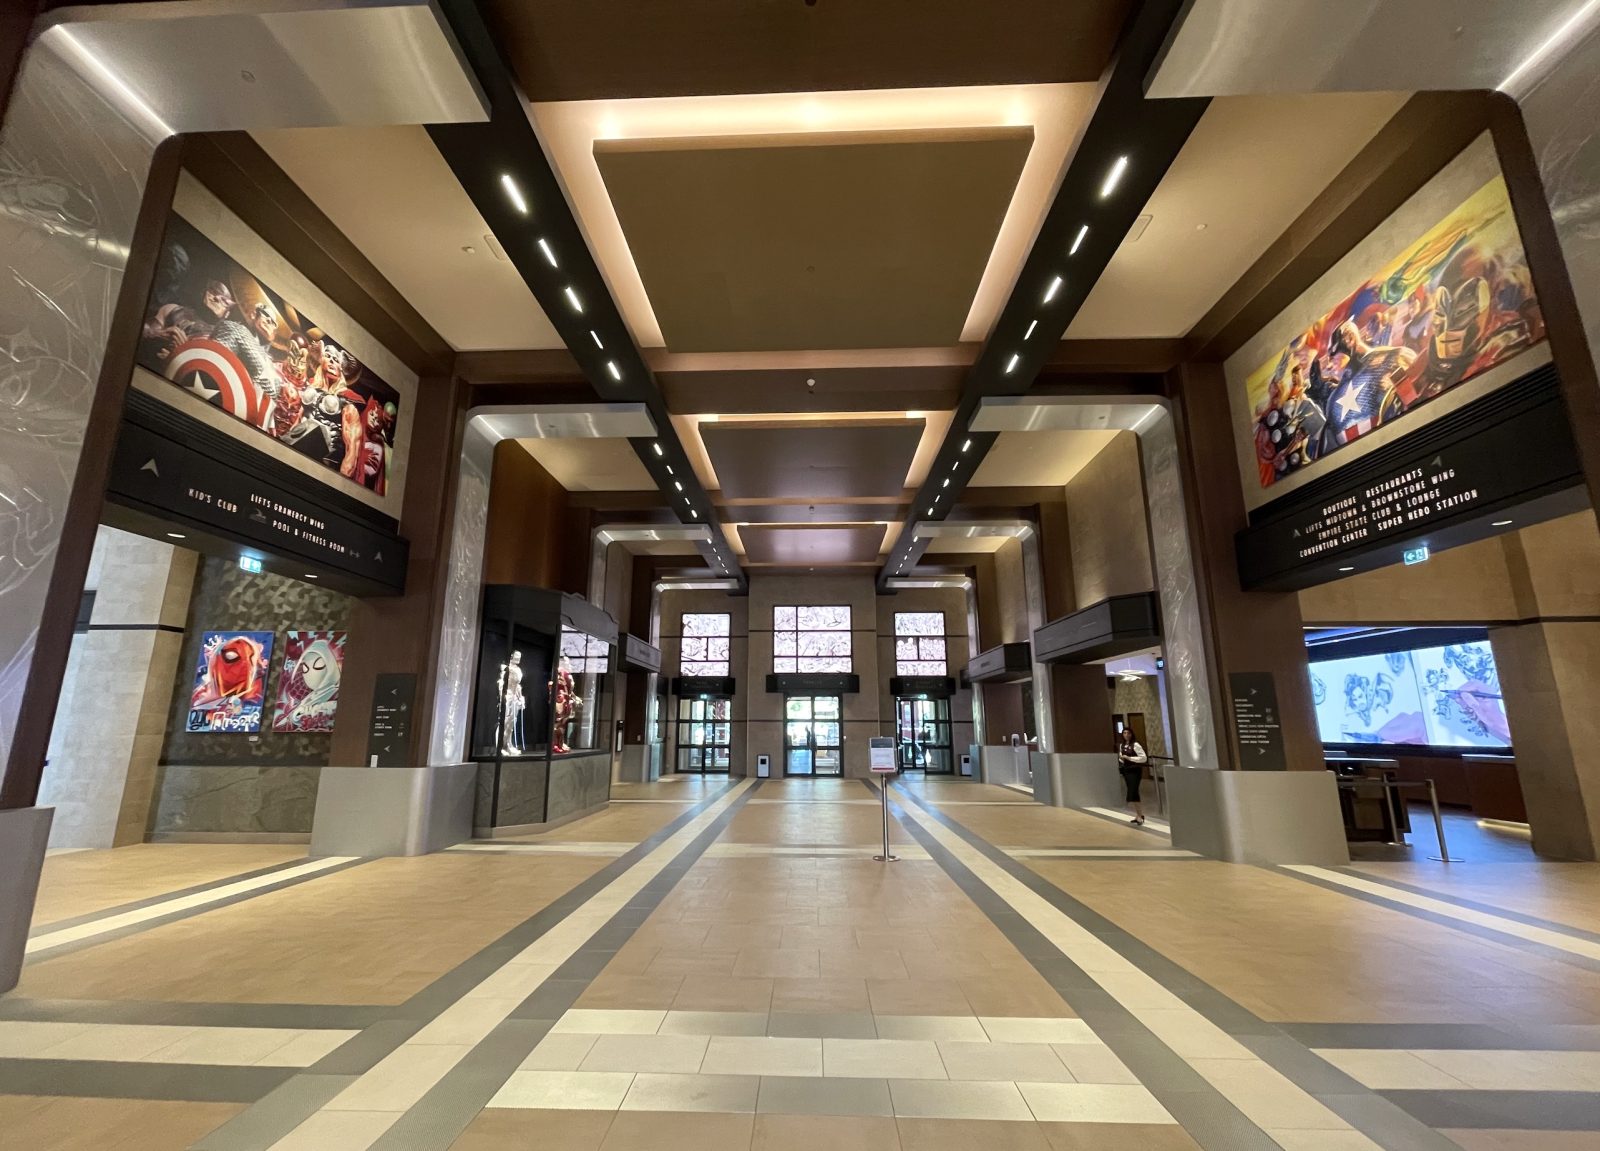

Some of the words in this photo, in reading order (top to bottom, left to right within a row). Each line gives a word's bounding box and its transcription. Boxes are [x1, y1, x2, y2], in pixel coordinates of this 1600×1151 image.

[188, 488, 212, 503] KID'S
[217, 499, 238, 513] CLUB
[250, 493, 271, 508] LIFTS
[274, 503, 307, 523] GRAMERCY
[309, 518, 325, 530] WING
[1305, 521, 1323, 534] LIFTS
[1326, 508, 1357, 526] MIDTOWN
[1361, 504, 1367, 512] &
[1371, 480, 1425, 508] BROWNSTONE
[1431, 468, 1455, 485] WING
[1318, 525, 1342, 541] EMPIRE
[1345, 515, 1368, 531] STATE
[1372, 507, 1391, 520] CLUB
[1396, 503, 1402, 512] &
[1407, 488, 1440, 508] LOUNGE
[1323, 496, 1356, 516] BOUTIQUE
[1366, 468, 1423, 498] RESTAURANTS
[272, 520, 290, 533] POOL
[302, 531, 326, 547] FITNESS
[329, 541, 345, 553] ROOM
[1300, 539, 1338, 557] CONVENTION
[1342, 528, 1368, 543] CENTER
[1378, 516, 1403, 531] SUPER
[1408, 506, 1430, 520] HERO
[1436, 489, 1478, 511] STATION
